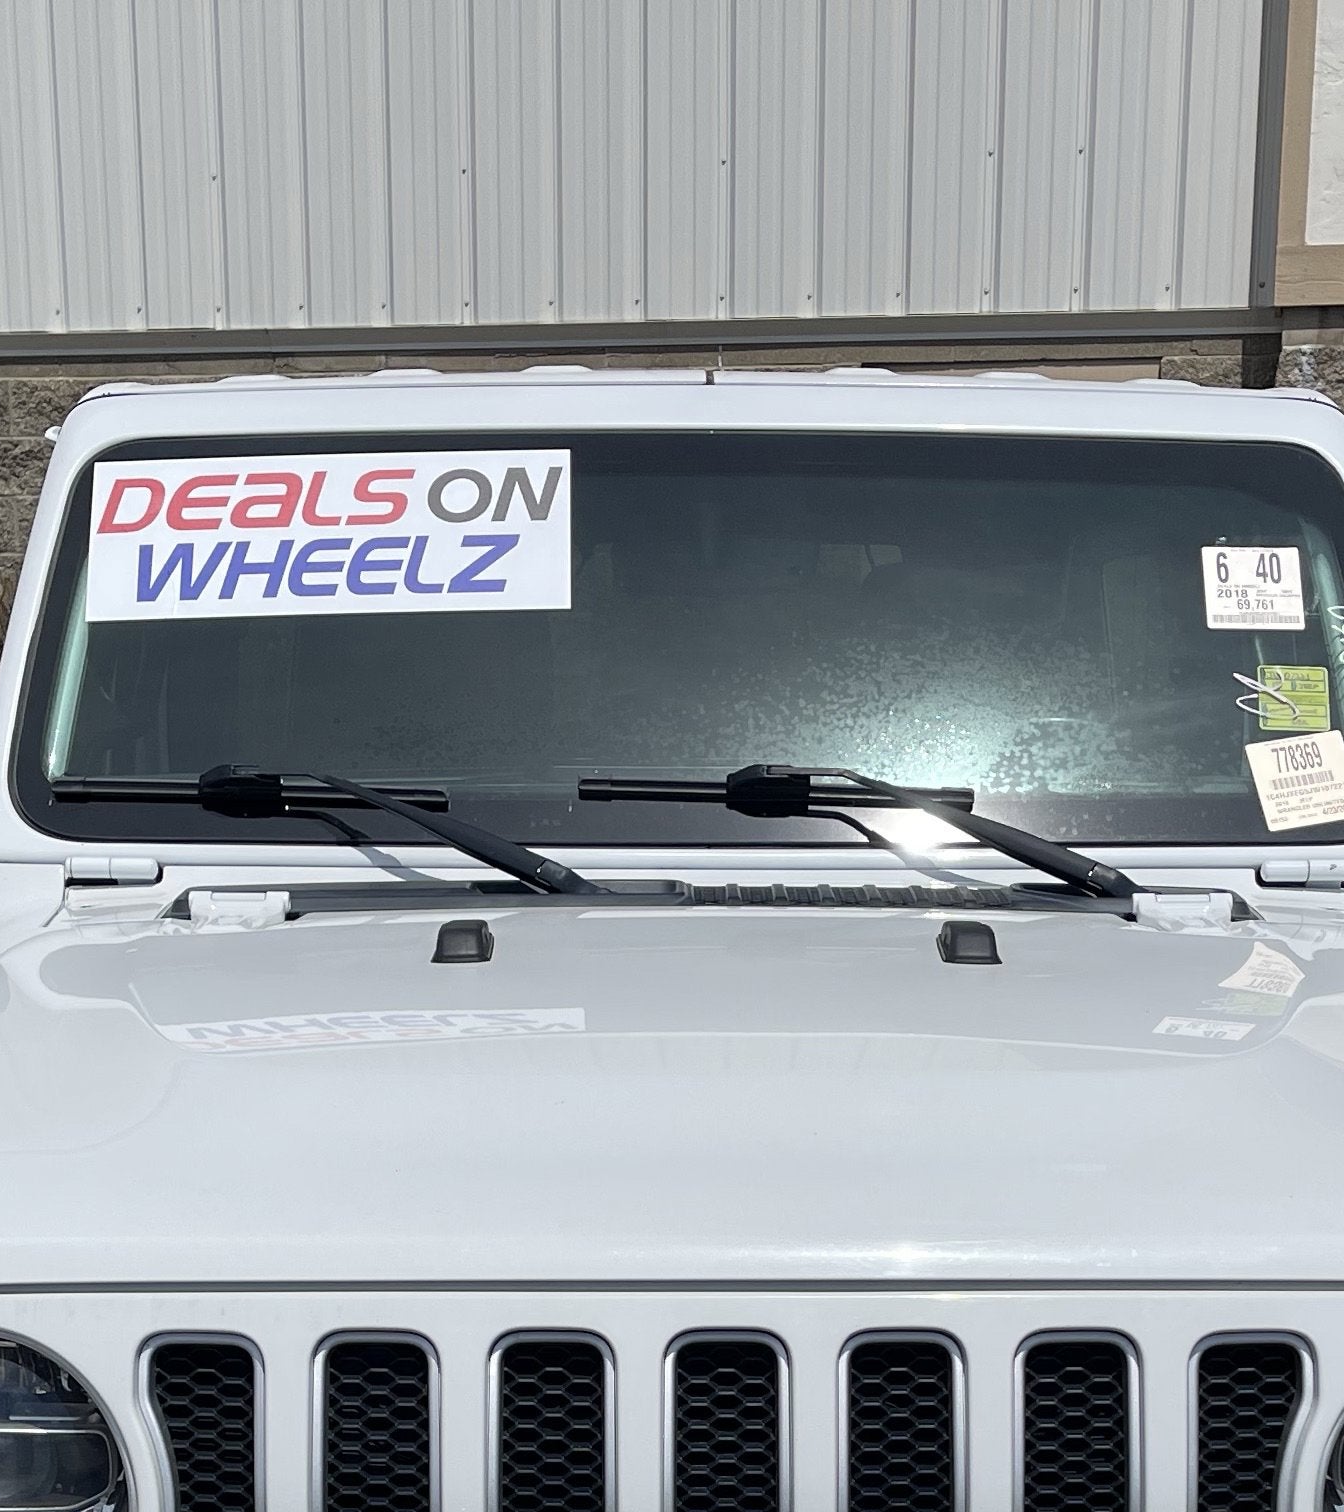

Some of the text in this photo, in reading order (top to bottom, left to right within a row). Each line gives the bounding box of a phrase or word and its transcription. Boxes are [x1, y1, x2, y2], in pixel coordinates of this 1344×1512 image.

[427, 466, 563, 523] ON
[136, 533, 520, 602] WHEELZ
[1216, 552, 1281, 584] 6 40
[1217, 589, 1248, 598] 2018
[1237, 599, 1274, 611] 69,761
[1271, 741, 1323, 773] 778369
